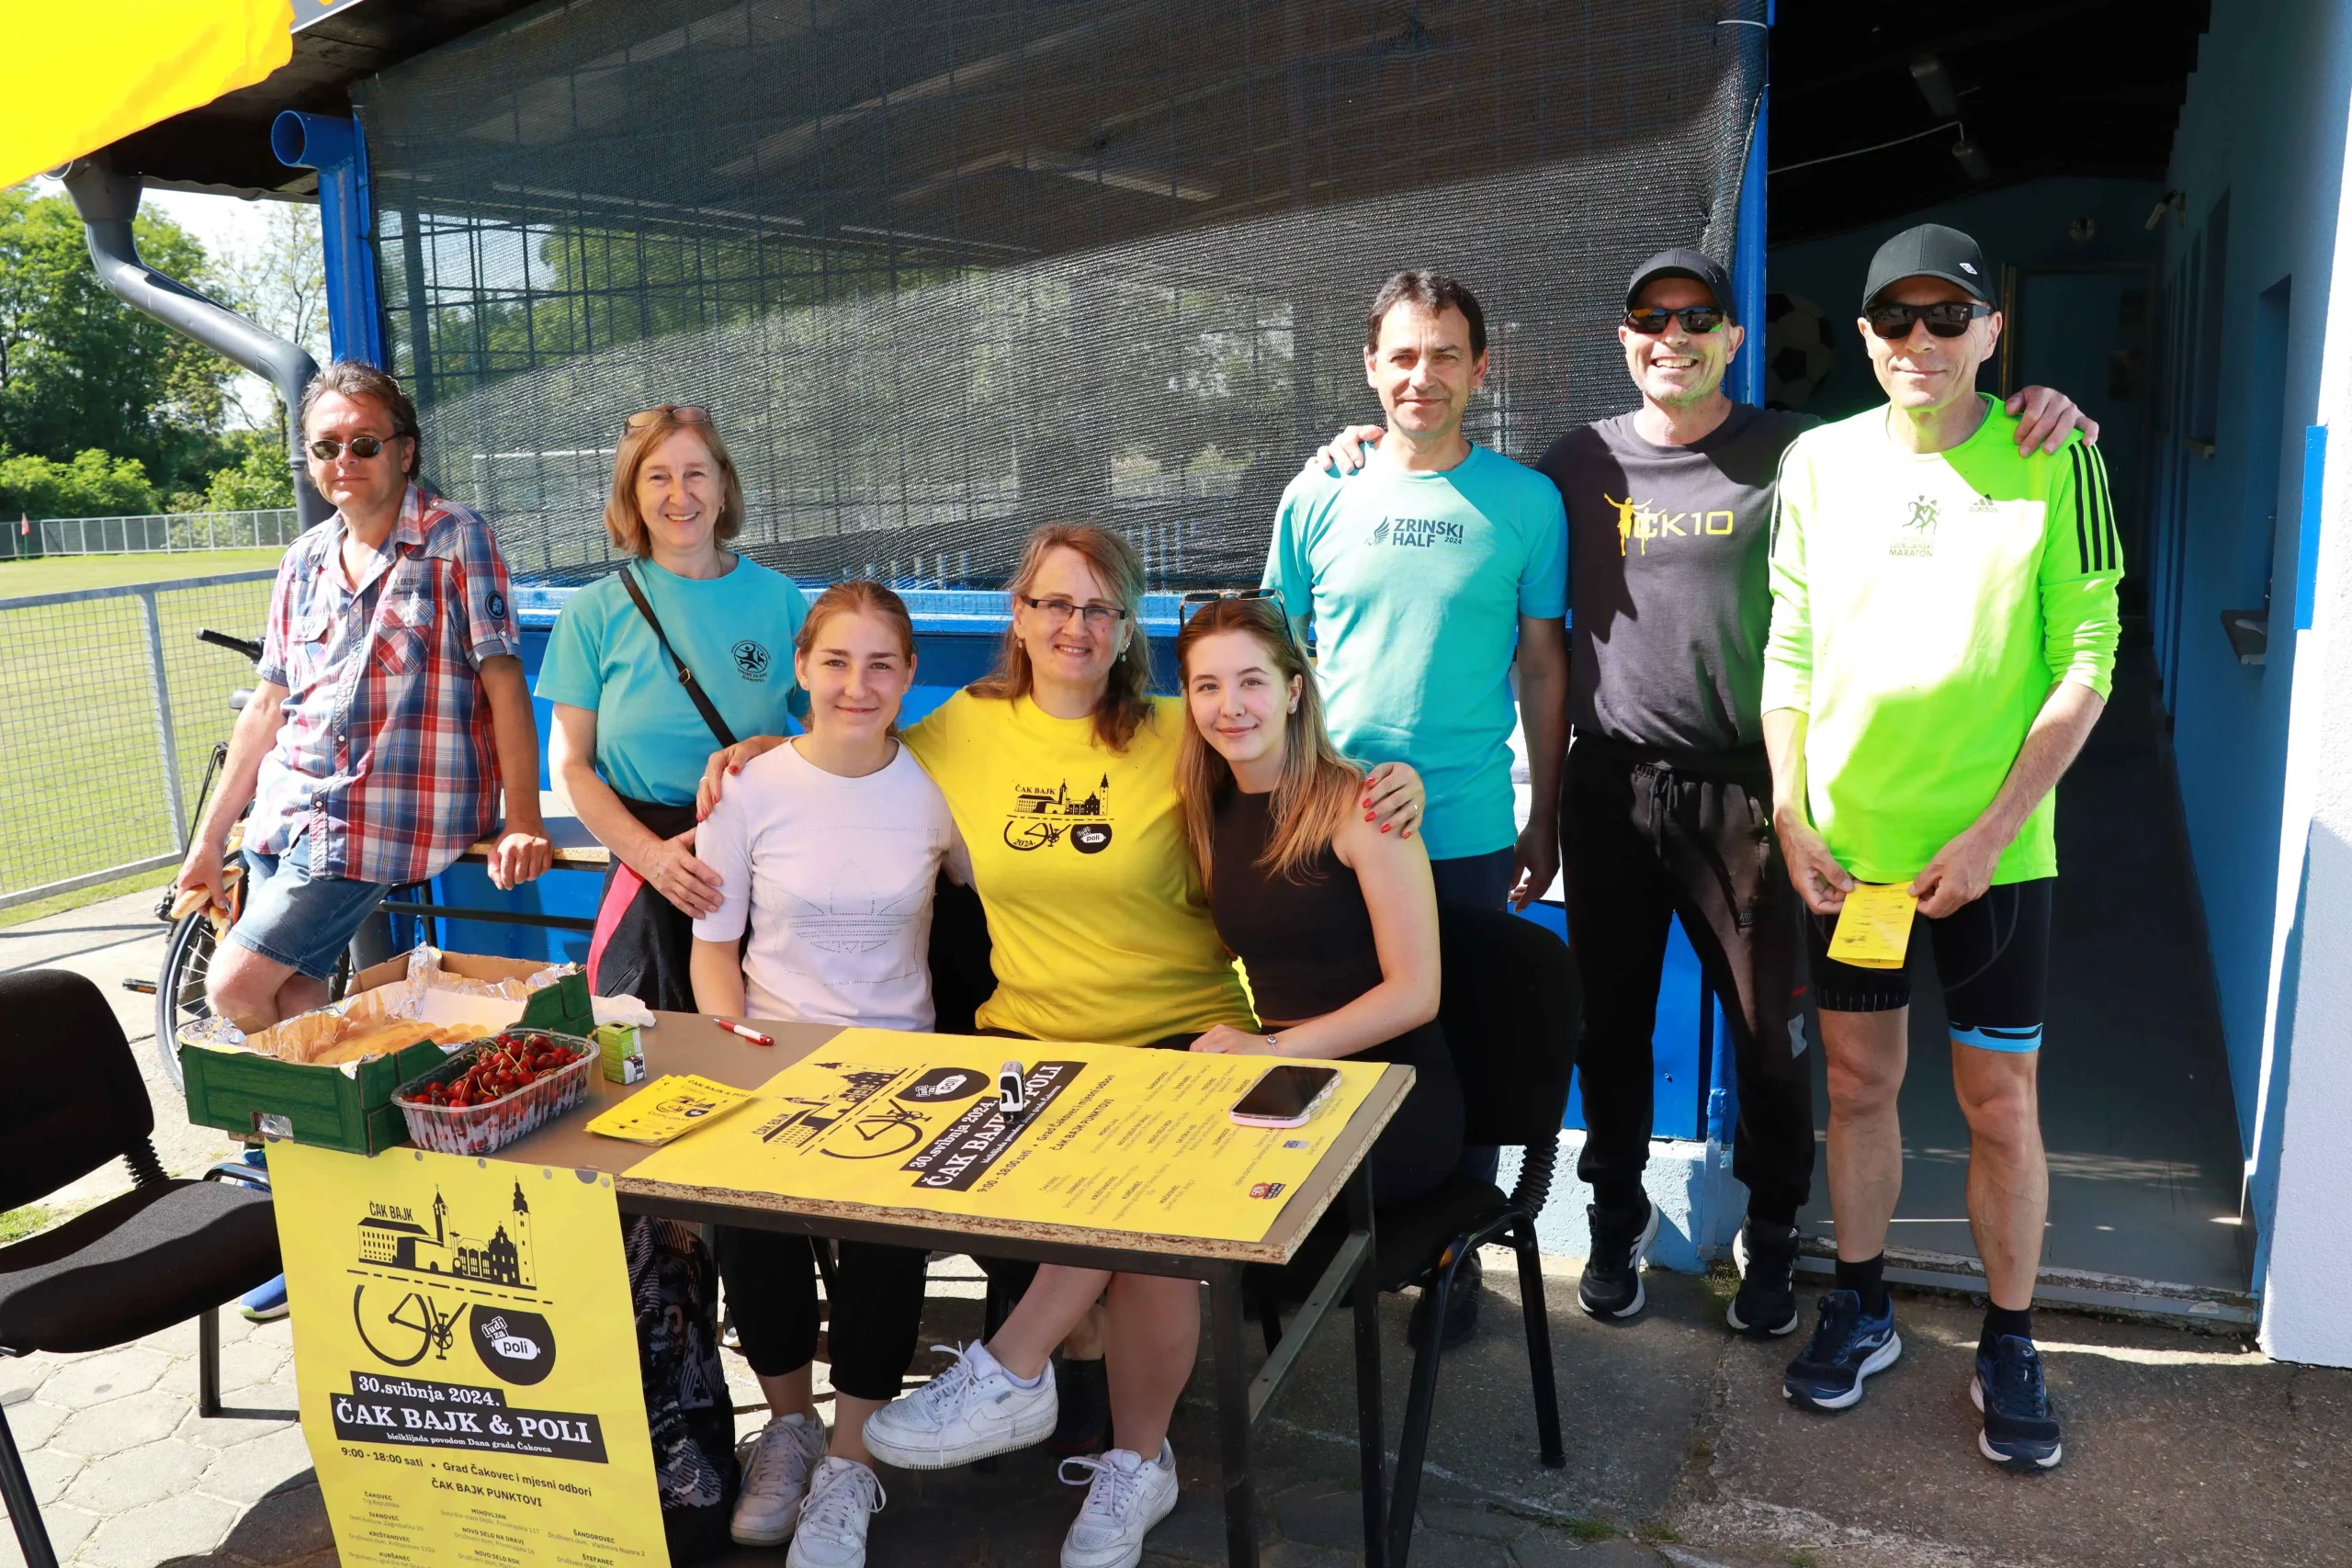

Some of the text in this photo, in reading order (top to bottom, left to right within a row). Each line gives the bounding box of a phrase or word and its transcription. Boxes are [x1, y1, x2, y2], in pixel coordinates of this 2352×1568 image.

[1394, 518, 1464, 538] ZRINSKI
[1392, 533, 1463, 547] HALF 2024
[1889, 549, 1933, 558] MARATON
[1015, 784, 1033, 794] ČAK
[1048, 1133, 1067, 1151] ČAK
[1062, 1118, 1087, 1140] BAJK
[1080, 1098, 1115, 1127] PUNKTOVI
[909, 1123, 971, 1168] 30.svibnja
[967, 1099, 999, 1123] 2024.
[977, 1178, 1000, 1193] 9:00
[996, 1158, 1022, 1177] 18:00
[1017, 1150, 1033, 1162] sati
[1036, 1126, 1056, 1142] Grad
[1052, 1107, 1078, 1133] Čakovec
[1079, 1089, 1100, 1109] mjesni
[1096, 1074, 1115, 1093] odbori
[921, 1154, 978, 1186] ČAK
[369, 1200, 413, 1222] ČAK BAJK
[483, 1317, 504, 1336] ludi
[493, 1329, 505, 1339] za
[503, 1341, 528, 1355] poli
[358, 1375, 501, 1407] 30.svibnja 2024.
[336, 1397, 592, 1443] ČAK BAJK & POLI
[386, 1432, 552, 1452] biciklijada povodom Dana grada Čakovca
[341, 1447, 364, 1459] 9:00
[374, 1451, 401, 1464] 18:00
[404, 1457, 424, 1467] sati
[443, 1461, 469, 1473] Grad
[470, 1463, 514, 1482] Čakovec
[522, 1476, 557, 1490] mjesni
[559, 1483, 593, 1496] odbori
[364, 1491, 392, 1501] ČAKOVEC
[431, 1476, 542, 1507] ČAK BAJK PUNKTOVI
[369, 1511, 400, 1521] IVANOVEC
[471, 1508, 506, 1520] MIHOVLJAN
[368, 1530, 411, 1542] KRIŠTANOVEC
[462, 1527, 479, 1536] NOVO
[480, 1530, 495, 1539] SELO
[505, 1535, 525, 1545] DRAVI
[573, 1529, 616, 1543] ŠANDOROVEC
[379, 1551, 411, 1562] KURŠANEC
[474, 1550, 491, 1559] NOVO
[492, 1553, 506, 1562] SELO
[507, 1557, 520, 1565] ROK
[582, 1553, 614, 1566] ŠTEFANEC
